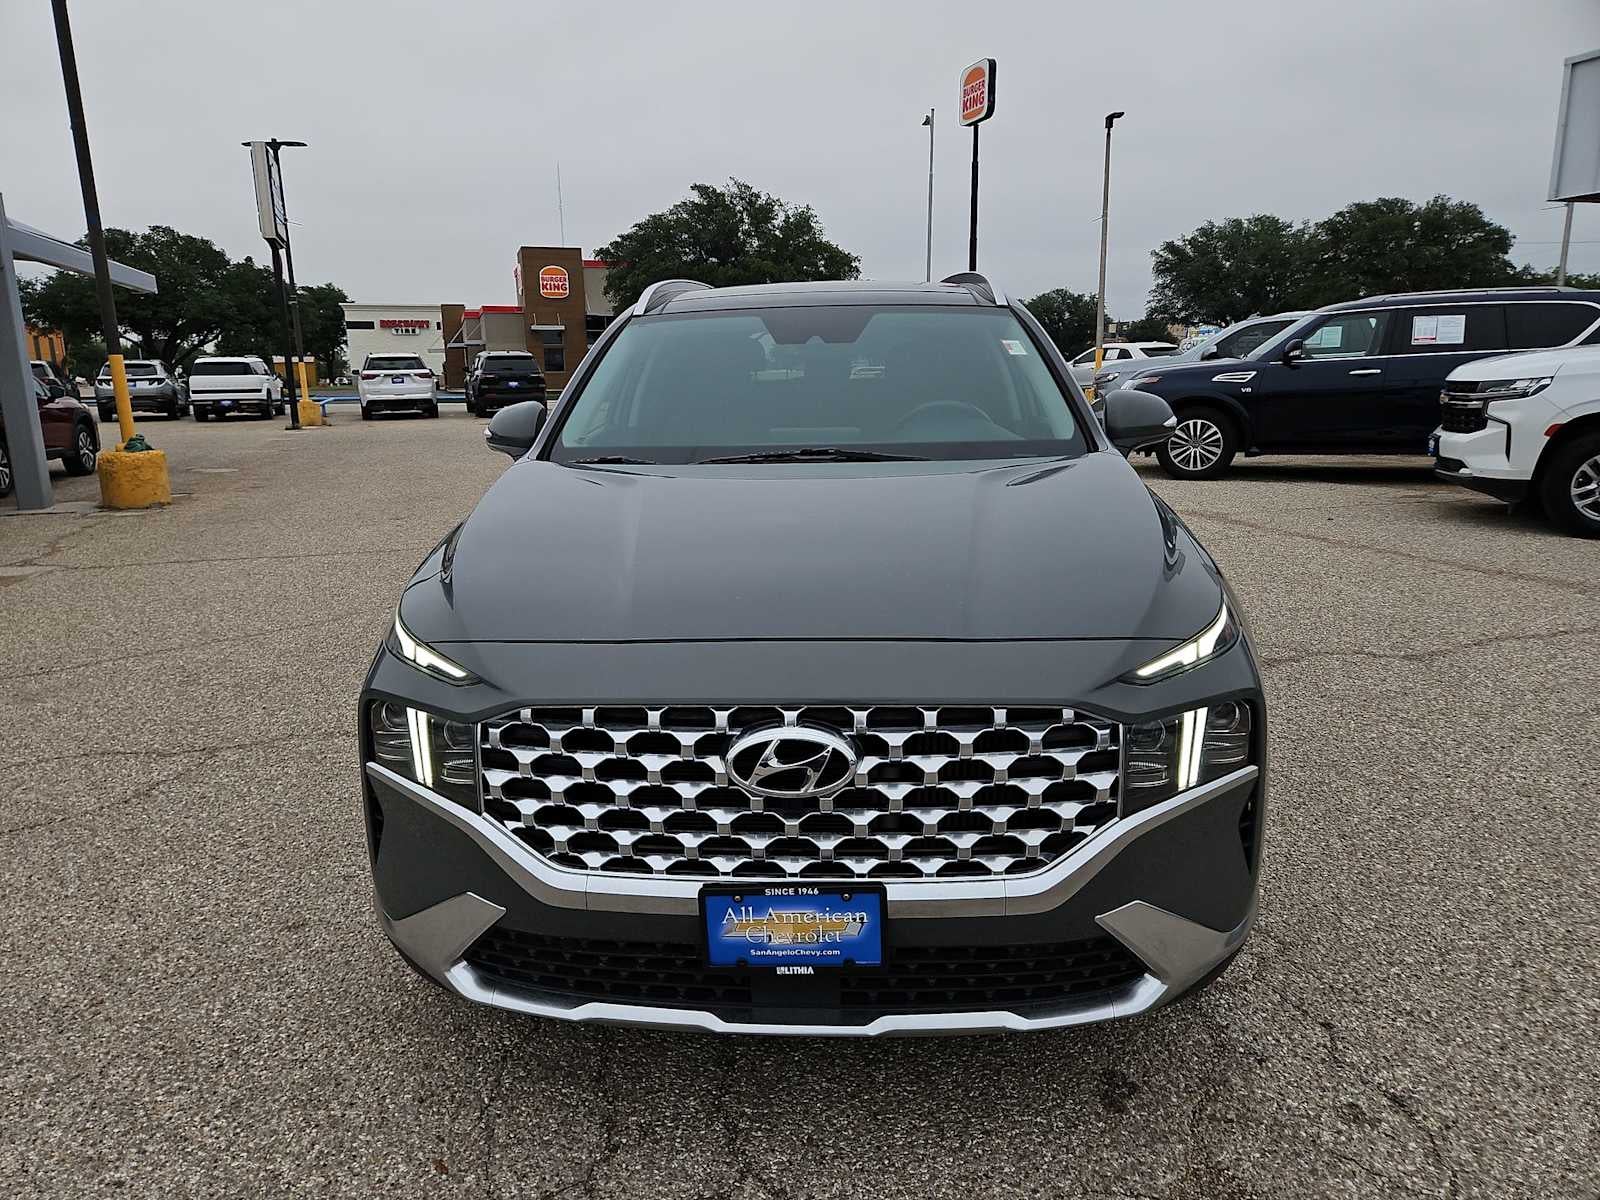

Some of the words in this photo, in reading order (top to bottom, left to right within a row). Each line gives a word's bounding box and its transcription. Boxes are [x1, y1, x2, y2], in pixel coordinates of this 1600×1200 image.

[963, 79, 985, 98] BURGER
[963, 91, 985, 113] KING
[541, 283, 568, 291] KING
[765, 888, 795, 896] SINCE
[798, 887, 819, 895] 1946
[722, 906, 753, 924] All
[761, 907, 868, 923] American
[746, 925, 842, 944] Chevrolet
[750, 949, 841, 957] SanAngeloChevy.com
[784, 966, 814, 975] LITHIA
